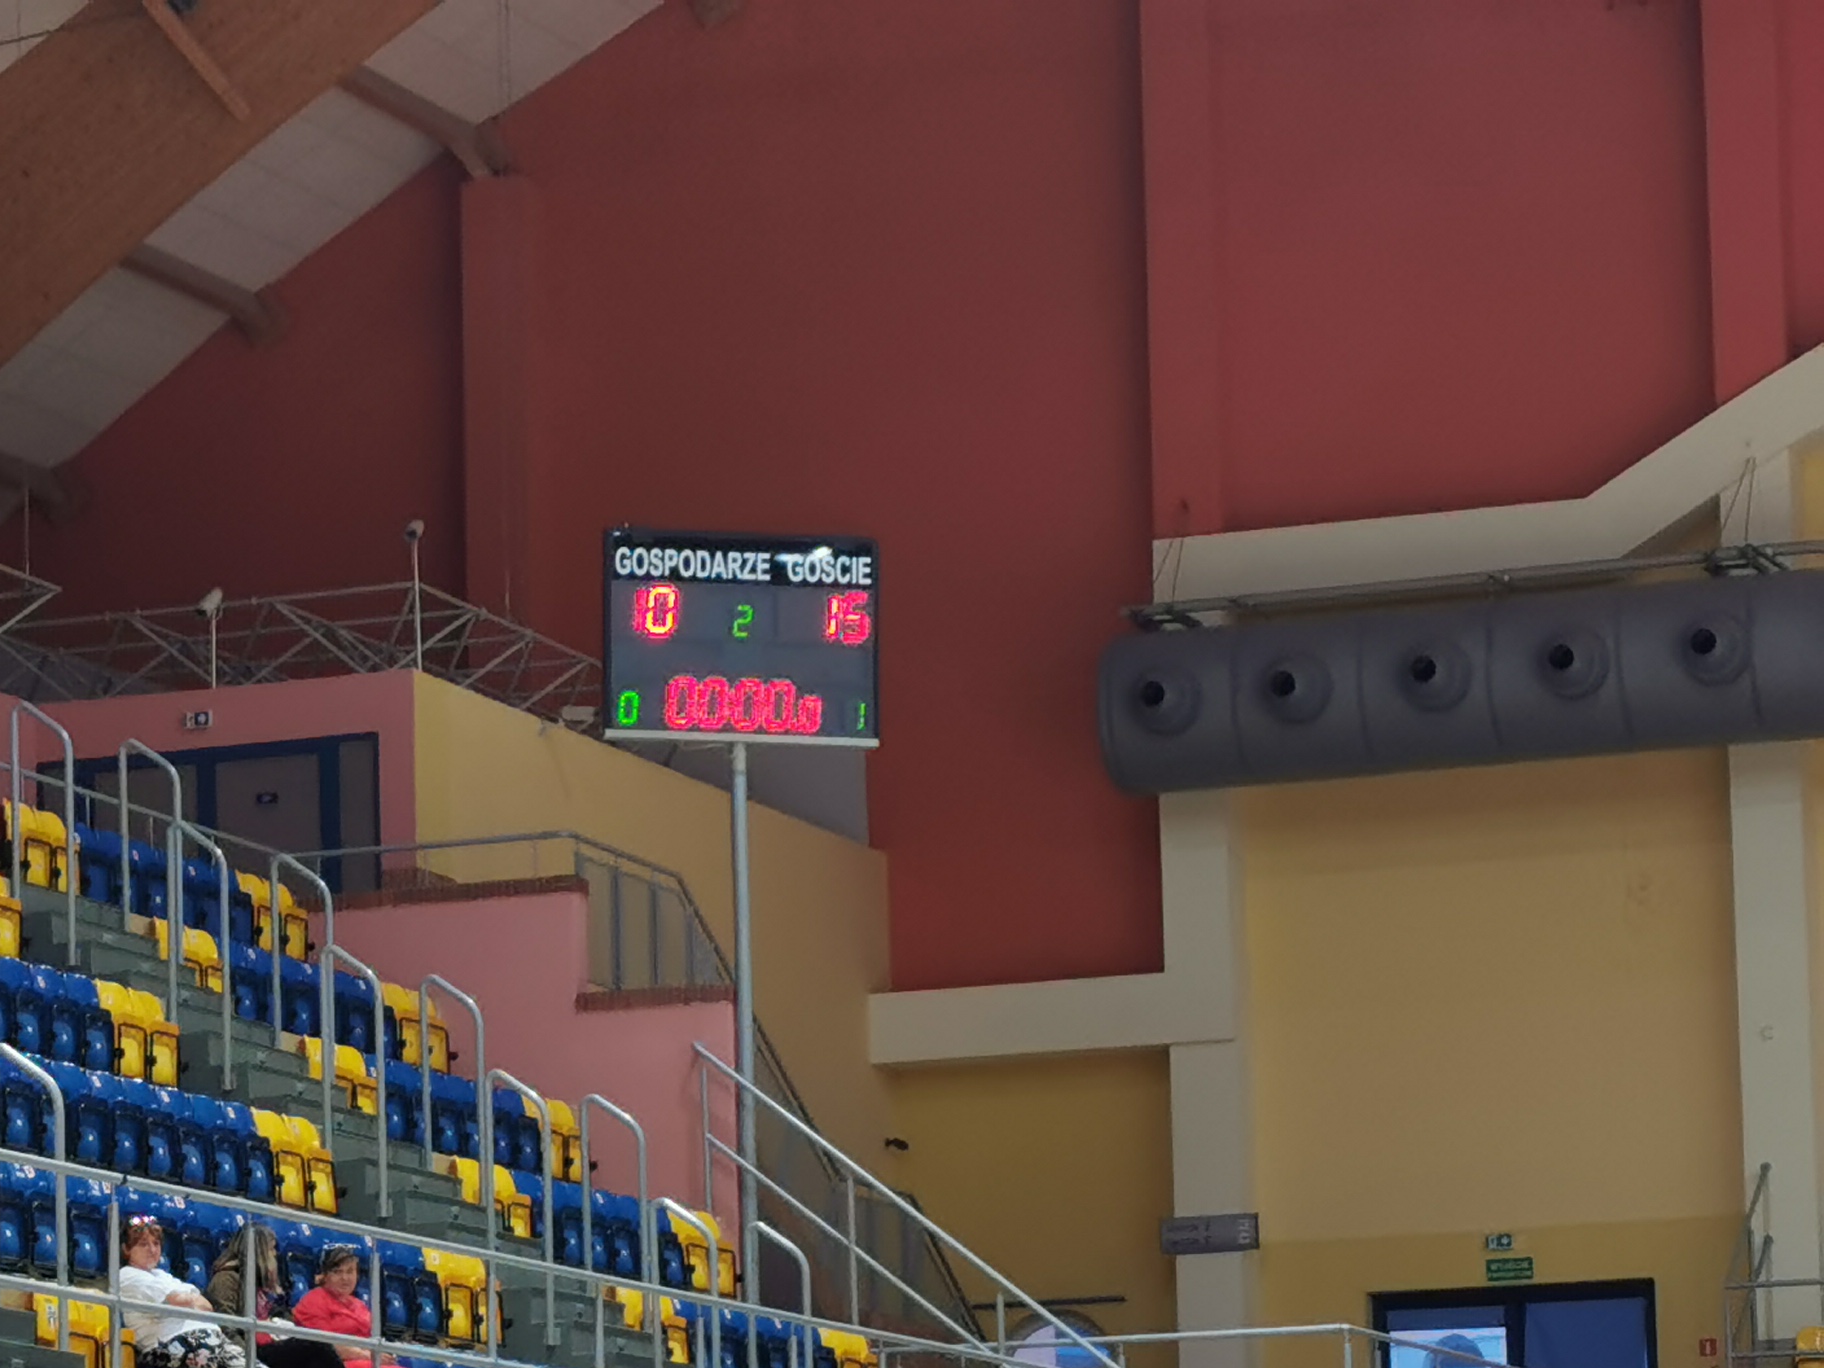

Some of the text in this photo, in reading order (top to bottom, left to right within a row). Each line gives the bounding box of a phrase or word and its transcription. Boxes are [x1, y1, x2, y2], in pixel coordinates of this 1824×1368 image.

[614, 546, 772, 581] GOSPODARZE
[632, 583, 871, 645] 10 2 15
[617, 690, 641, 726] 0
